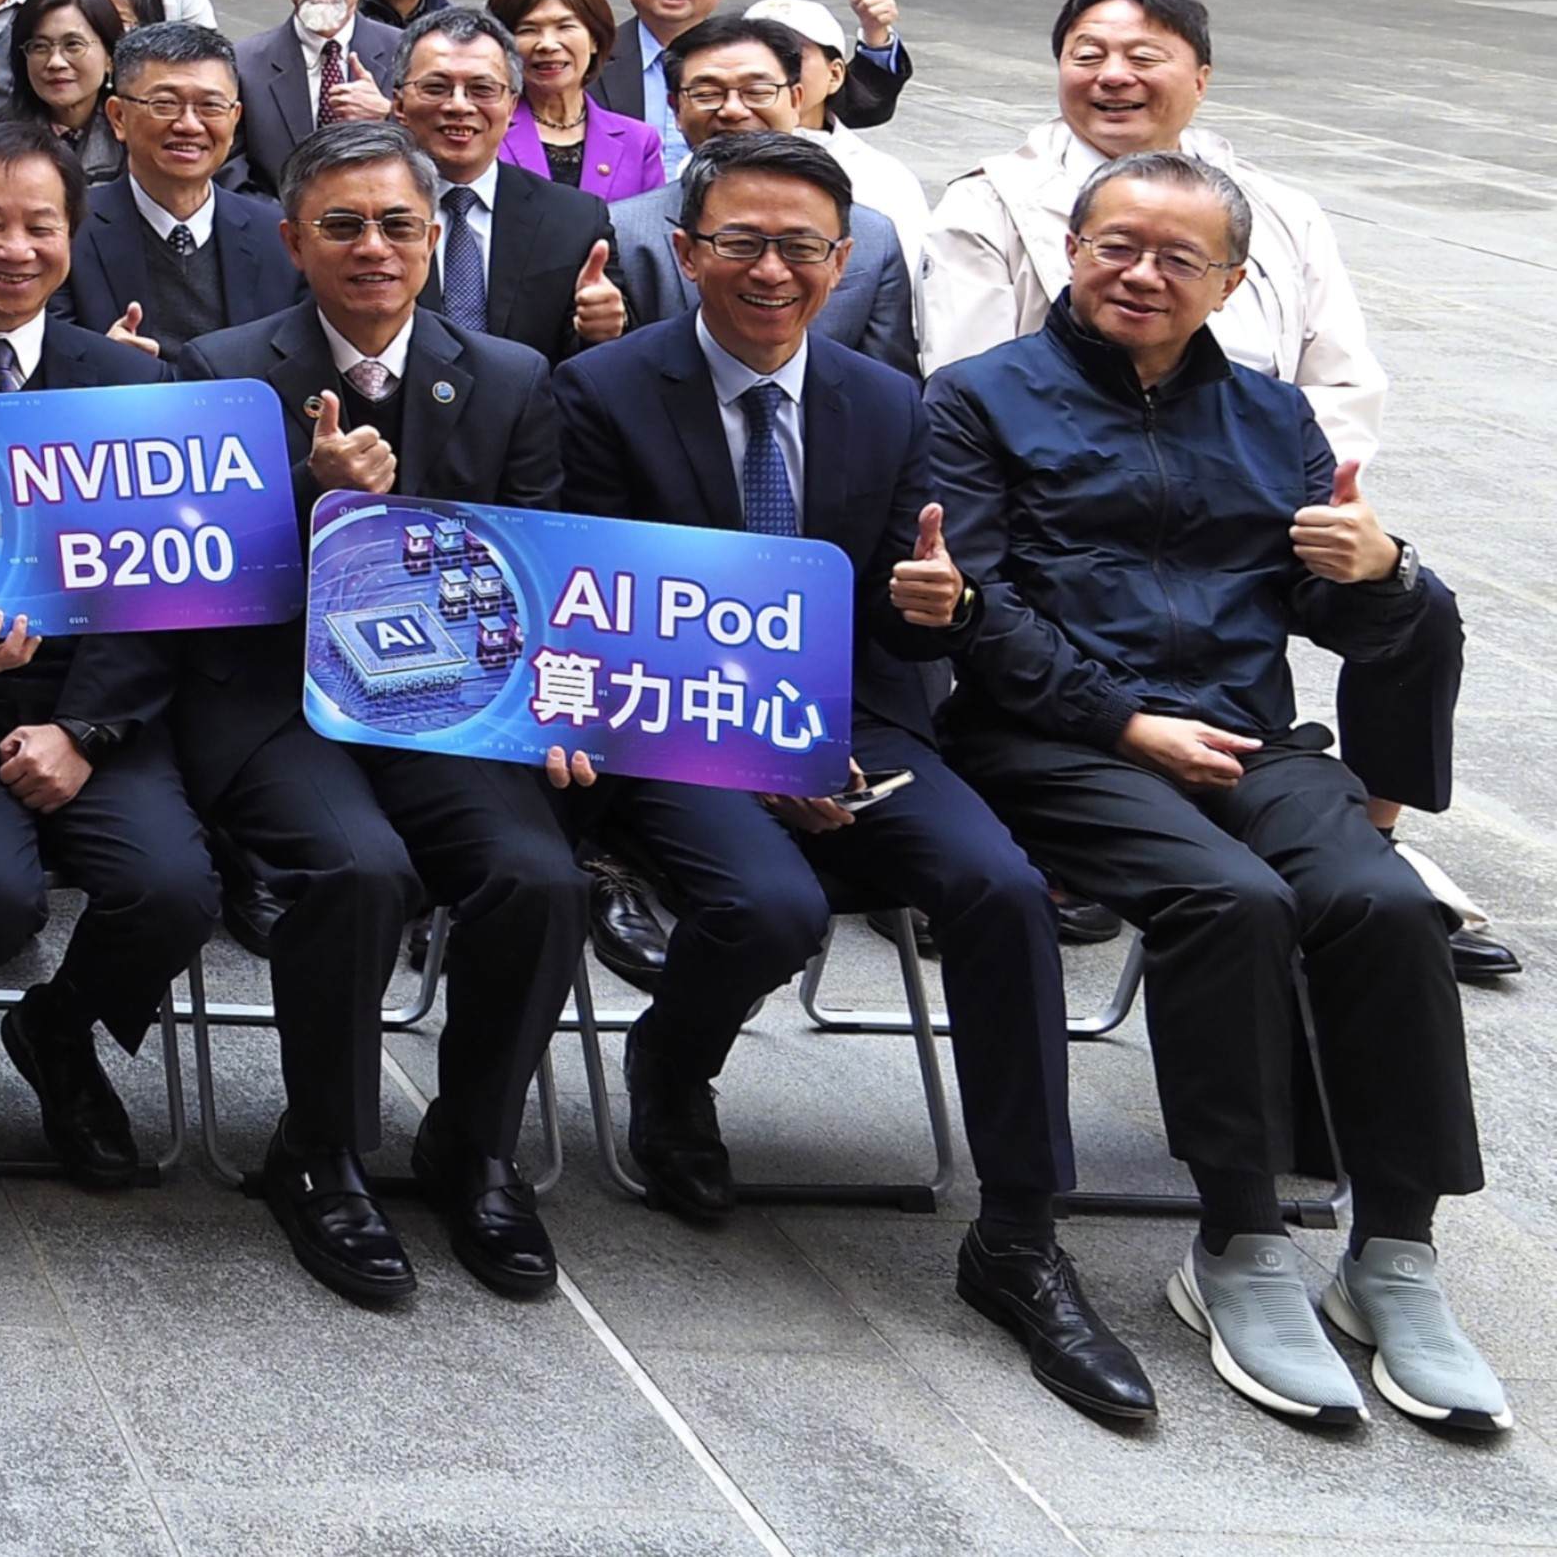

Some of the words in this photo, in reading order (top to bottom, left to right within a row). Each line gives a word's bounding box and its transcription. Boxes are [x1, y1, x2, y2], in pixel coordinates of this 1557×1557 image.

[11, 435, 265, 504] NVIDIA
[58, 523, 236, 590] B200
[376, 620, 428, 650] AI
[552, 569, 632, 633] AI
[658, 577, 803, 652] Pod
[531, 649, 824, 752] 算力中心
